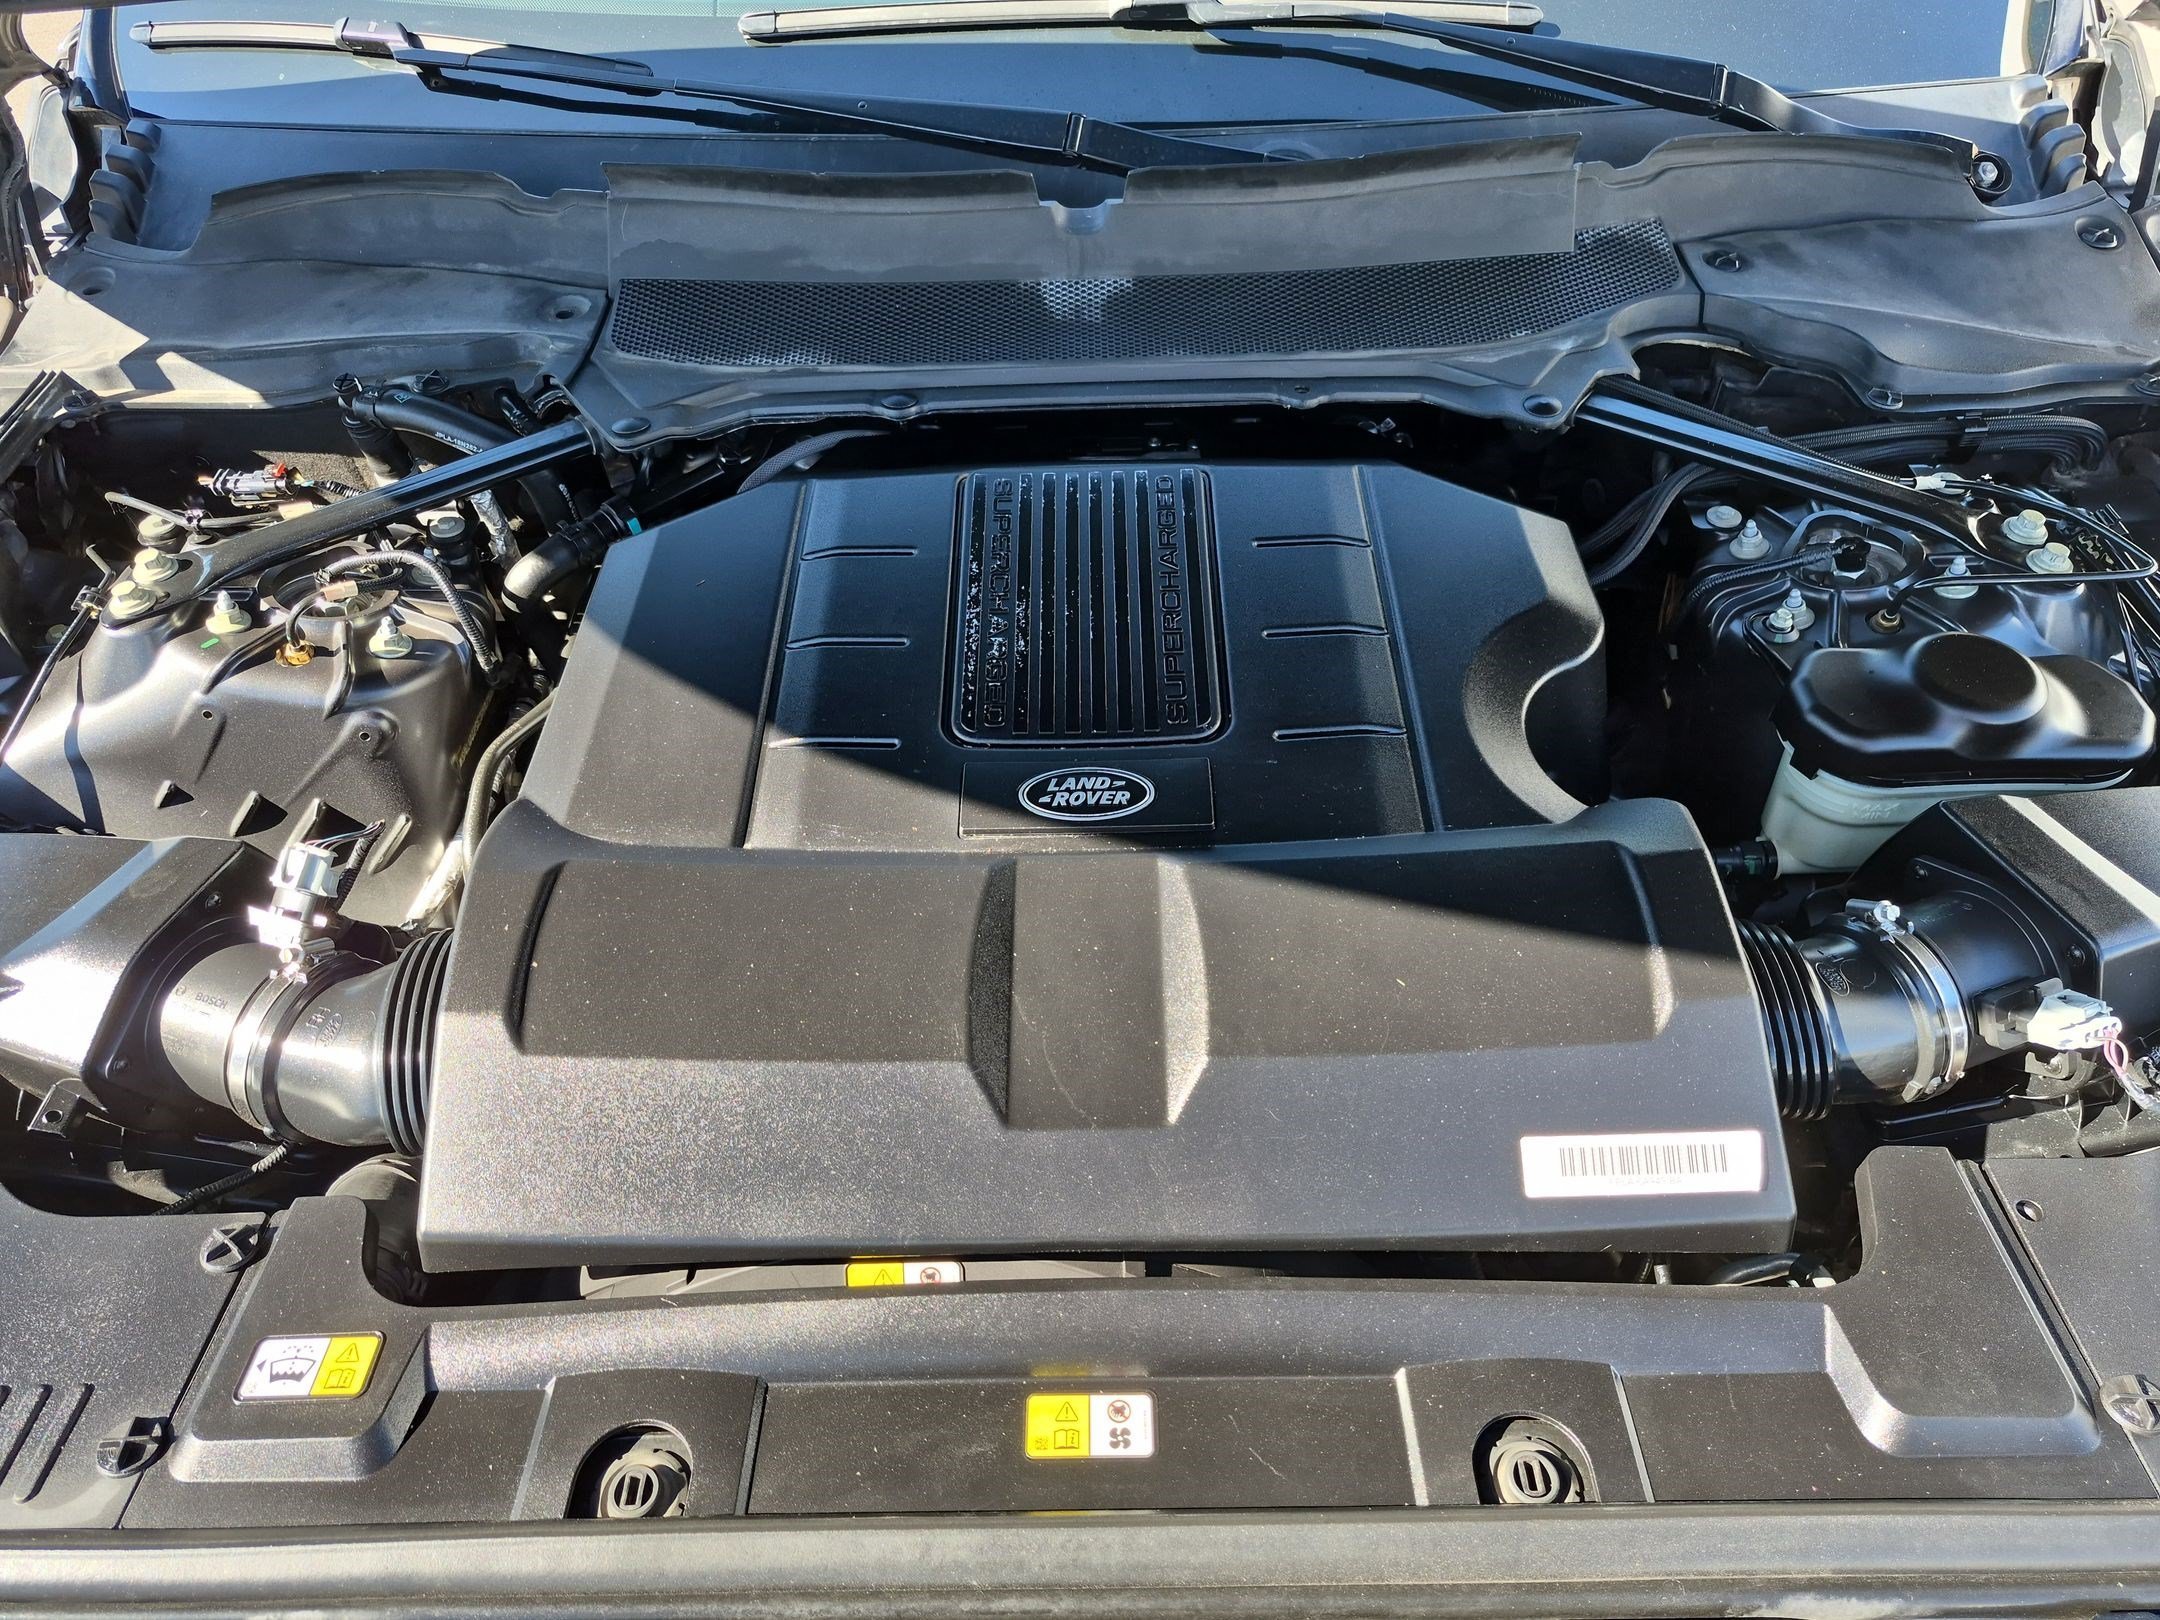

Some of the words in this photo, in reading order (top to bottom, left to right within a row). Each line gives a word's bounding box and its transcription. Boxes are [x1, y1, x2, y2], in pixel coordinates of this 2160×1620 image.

[983, 478, 1013, 727] SUPERCHARGED
[1154, 474, 1188, 725] SUPERCHARGED
[1047, 776, 1111, 792] LAND
[1051, 790, 1131, 807] ROVER
[195, 992, 228, 1009] BOSCH
